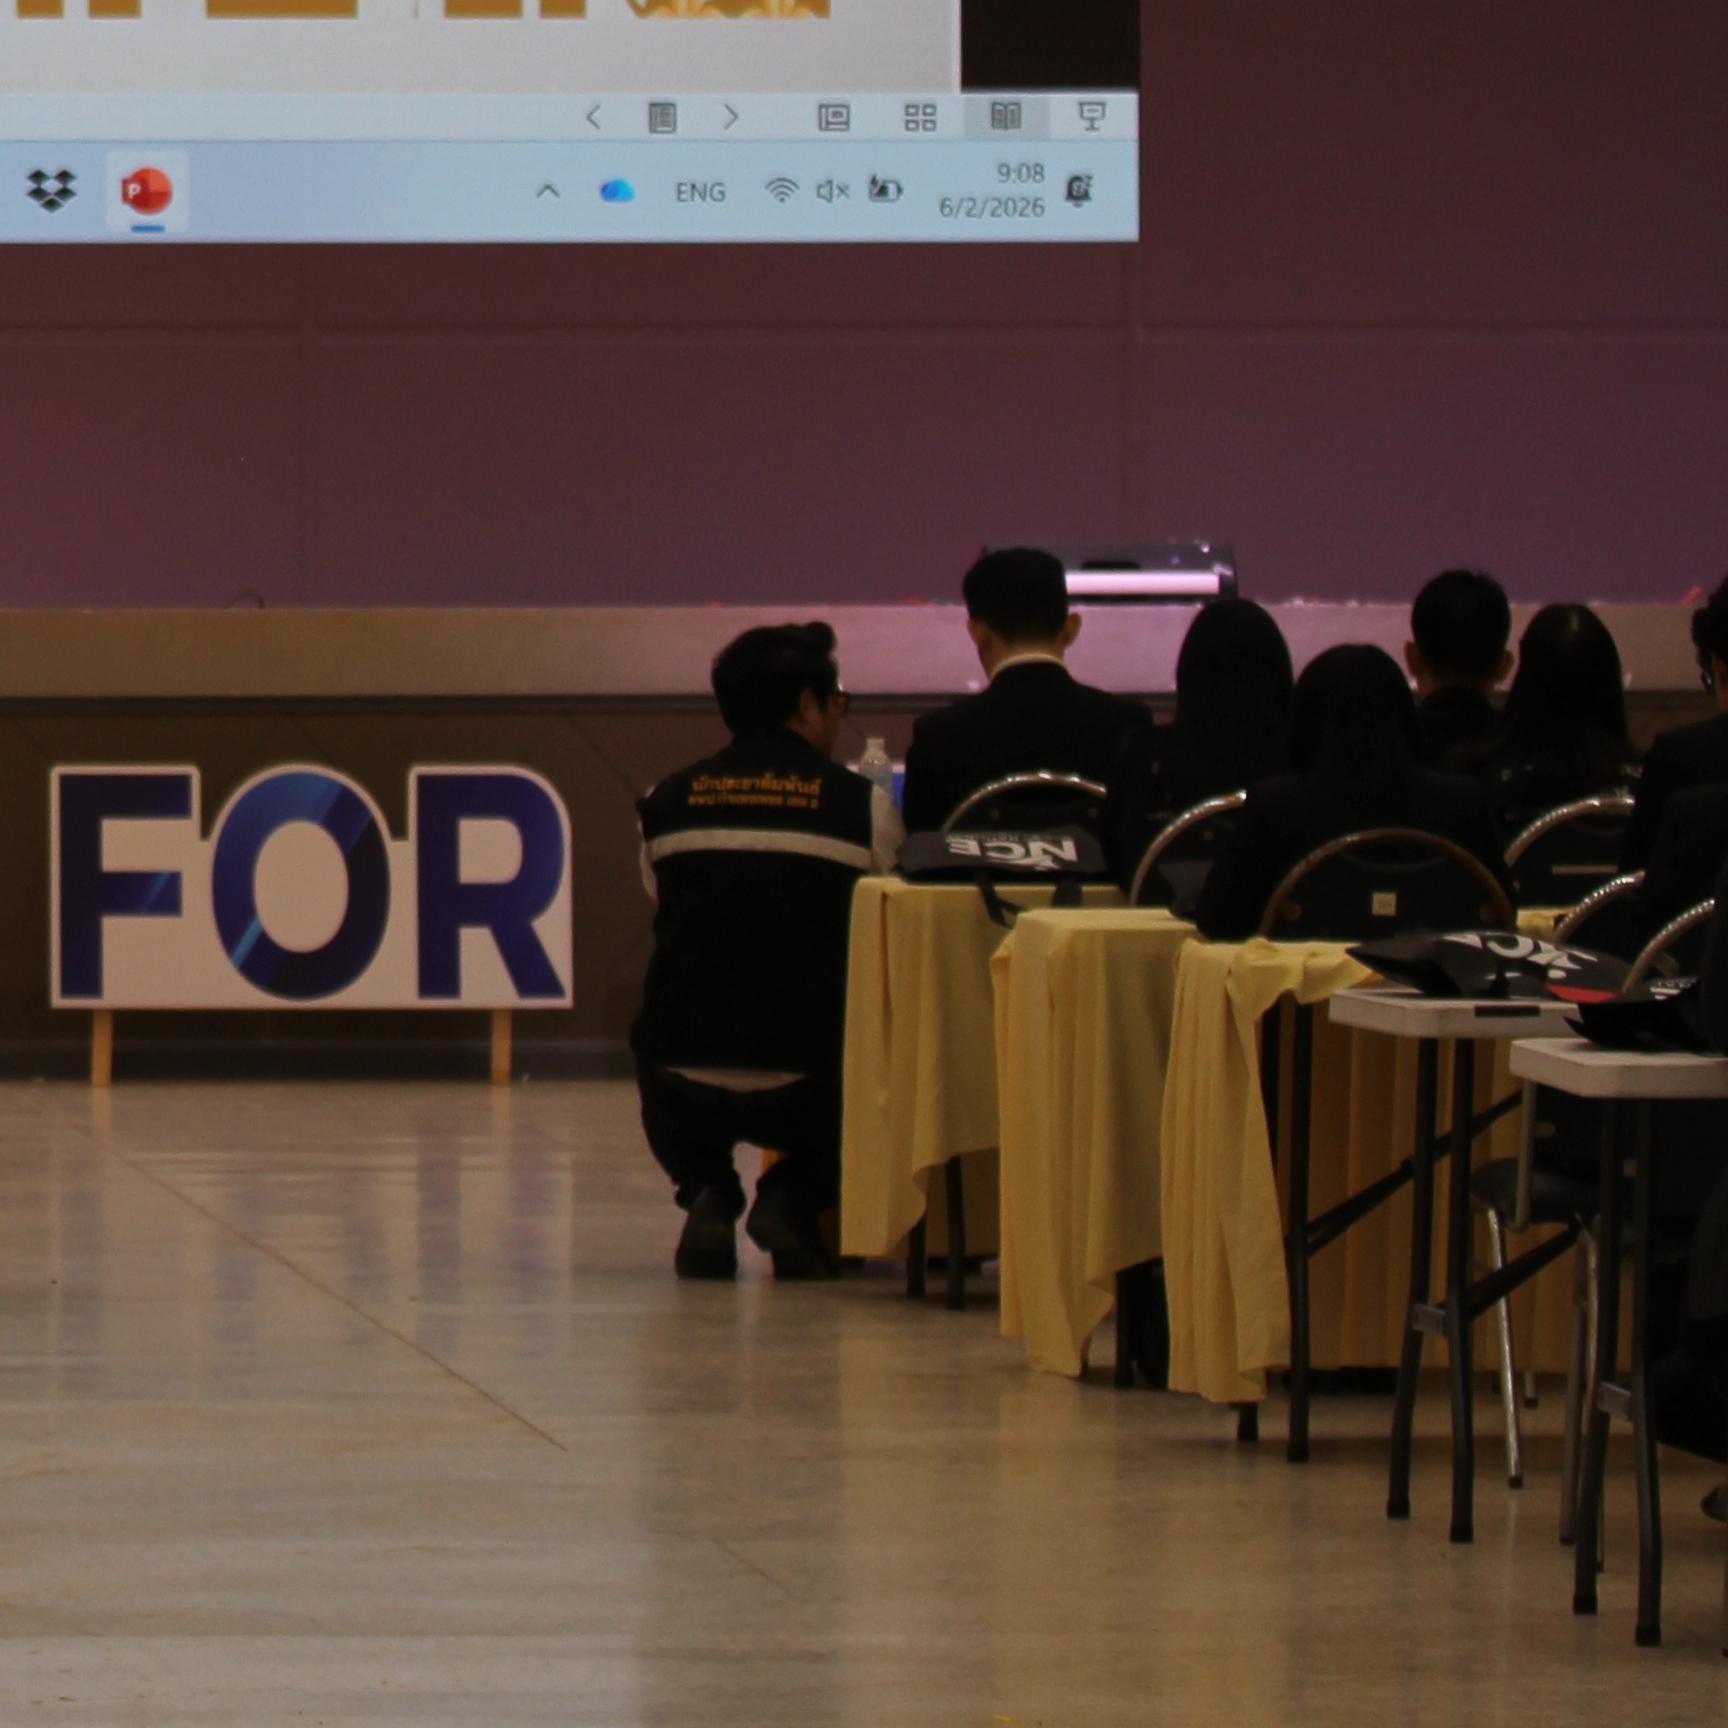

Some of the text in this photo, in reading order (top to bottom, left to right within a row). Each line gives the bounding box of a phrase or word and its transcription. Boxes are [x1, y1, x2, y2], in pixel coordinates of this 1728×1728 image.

[998, 163, 1046, 185] 9:08
[677, 182, 727, 204] ENG
[940, 197, 1046, 220] 6/2/2026
[58, 769, 567, 1003] FOR
